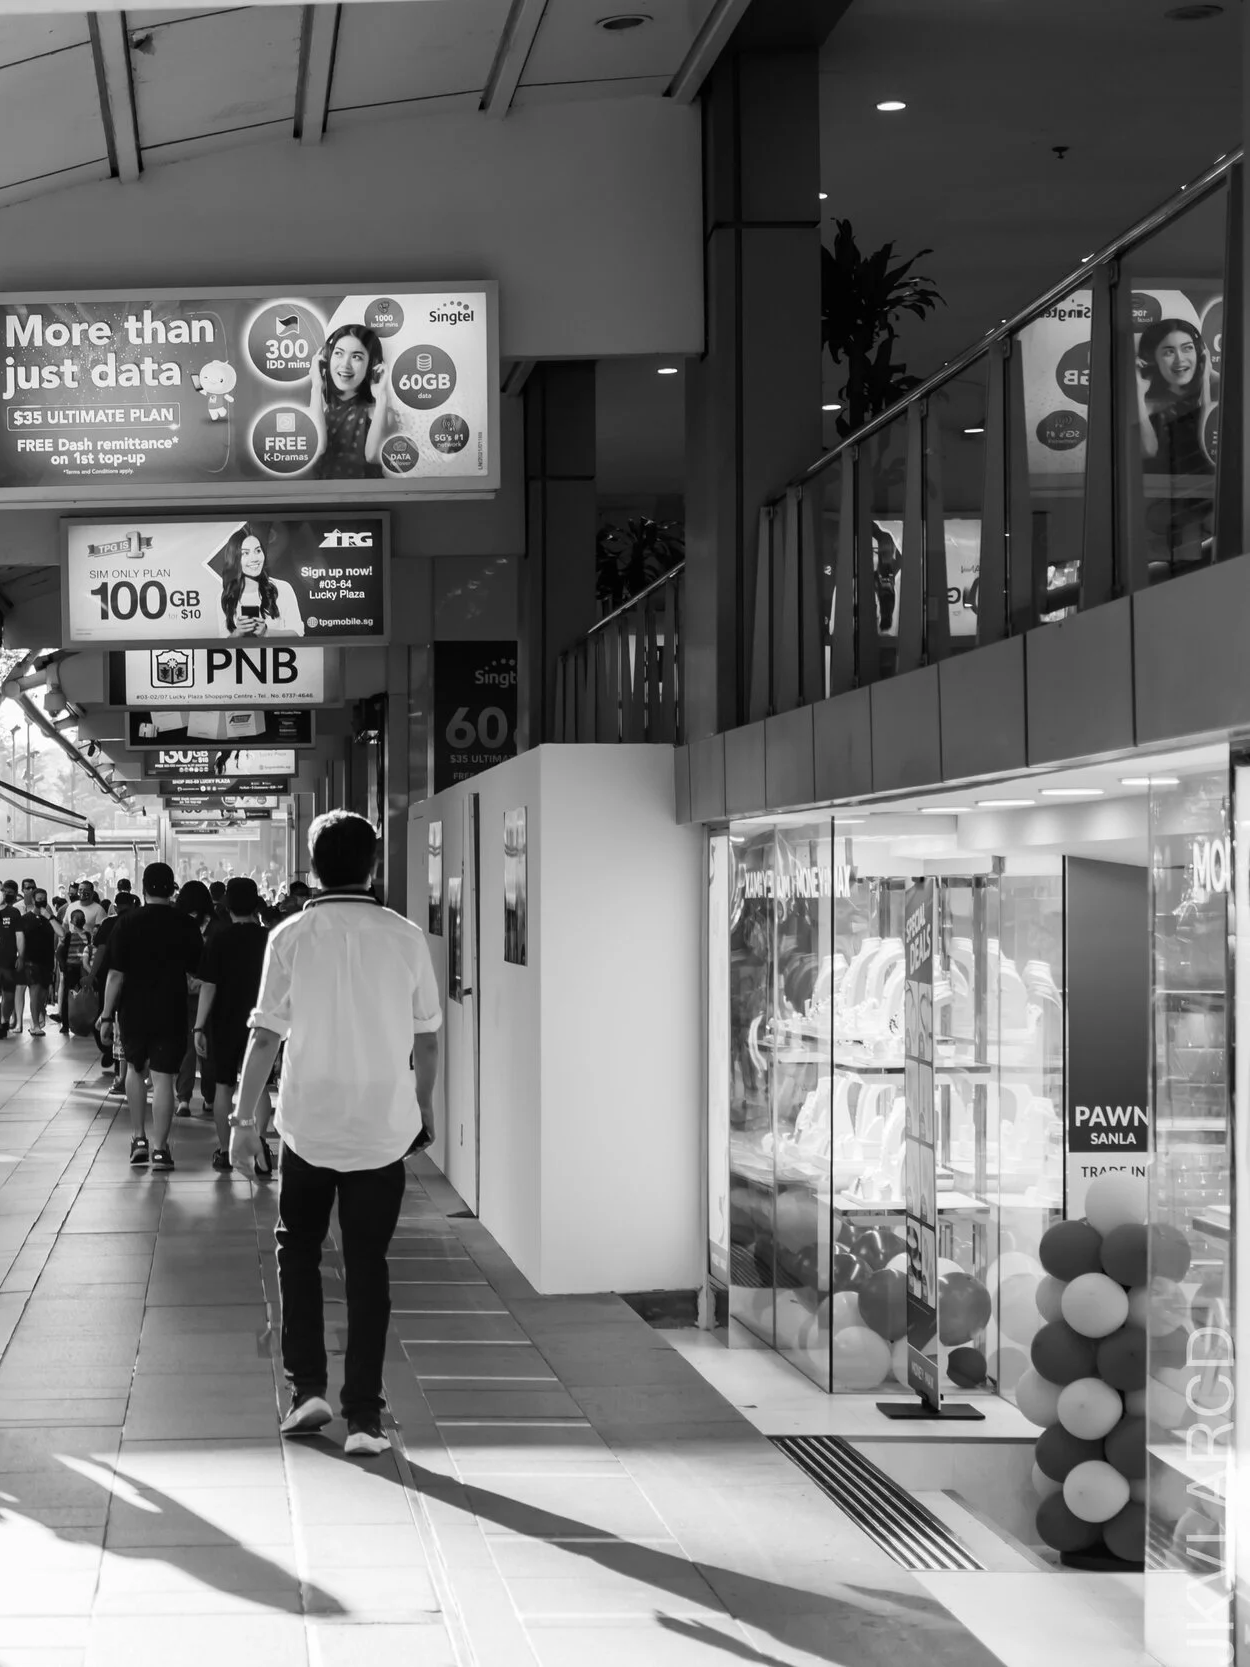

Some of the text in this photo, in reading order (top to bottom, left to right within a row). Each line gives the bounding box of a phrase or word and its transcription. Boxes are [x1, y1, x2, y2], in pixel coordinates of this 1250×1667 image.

[375, 314, 393, 322] 1000
[429, 310, 474, 325] Singtel
[5, 310, 214, 347] More than
[266, 339, 308, 359] 300
[266, 360, 310, 369] IDD mins
[2, 353, 181, 399] just data
[399, 373, 450, 390] 60GB
[14, 408, 174, 425] $35 ULTIMATE PLAN
[17, 439, 53, 451] FREE
[58, 437, 92, 451] Dash
[265, 436, 307, 451] FREE
[434, 434, 452, 442] SG's
[51, 452, 146, 467] on 1st top-up
[264, 453, 308, 462] K-Dramas
[390, 453, 411, 461] DATA
[98, 531, 144, 558] TPG IS 1
[89, 569, 171, 579] SIM ONLY PLAN
[301, 565, 373, 579] Sign up now!
[319, 580, 352, 589] #03-64
[91, 580, 200, 620] 100 GB
[310, 590, 365, 601] Lucky Plaza
[168, 609, 201, 620] for $10
[319, 618, 373, 627] tpgmobile.sg
[207, 647, 298, 684] PNB
[475, 670, 517, 688] Singt
[204, 693, 232, 701] Shopping
[445, 706, 517, 749] 60
[450, 755, 468, 764] $35
[906, 902, 926, 944] SPECIAL
[910, 923, 931, 975] DEALS
[1075, 1106, 1148, 1127] PAWN
[1090, 1132, 1137, 1145] SANLA
